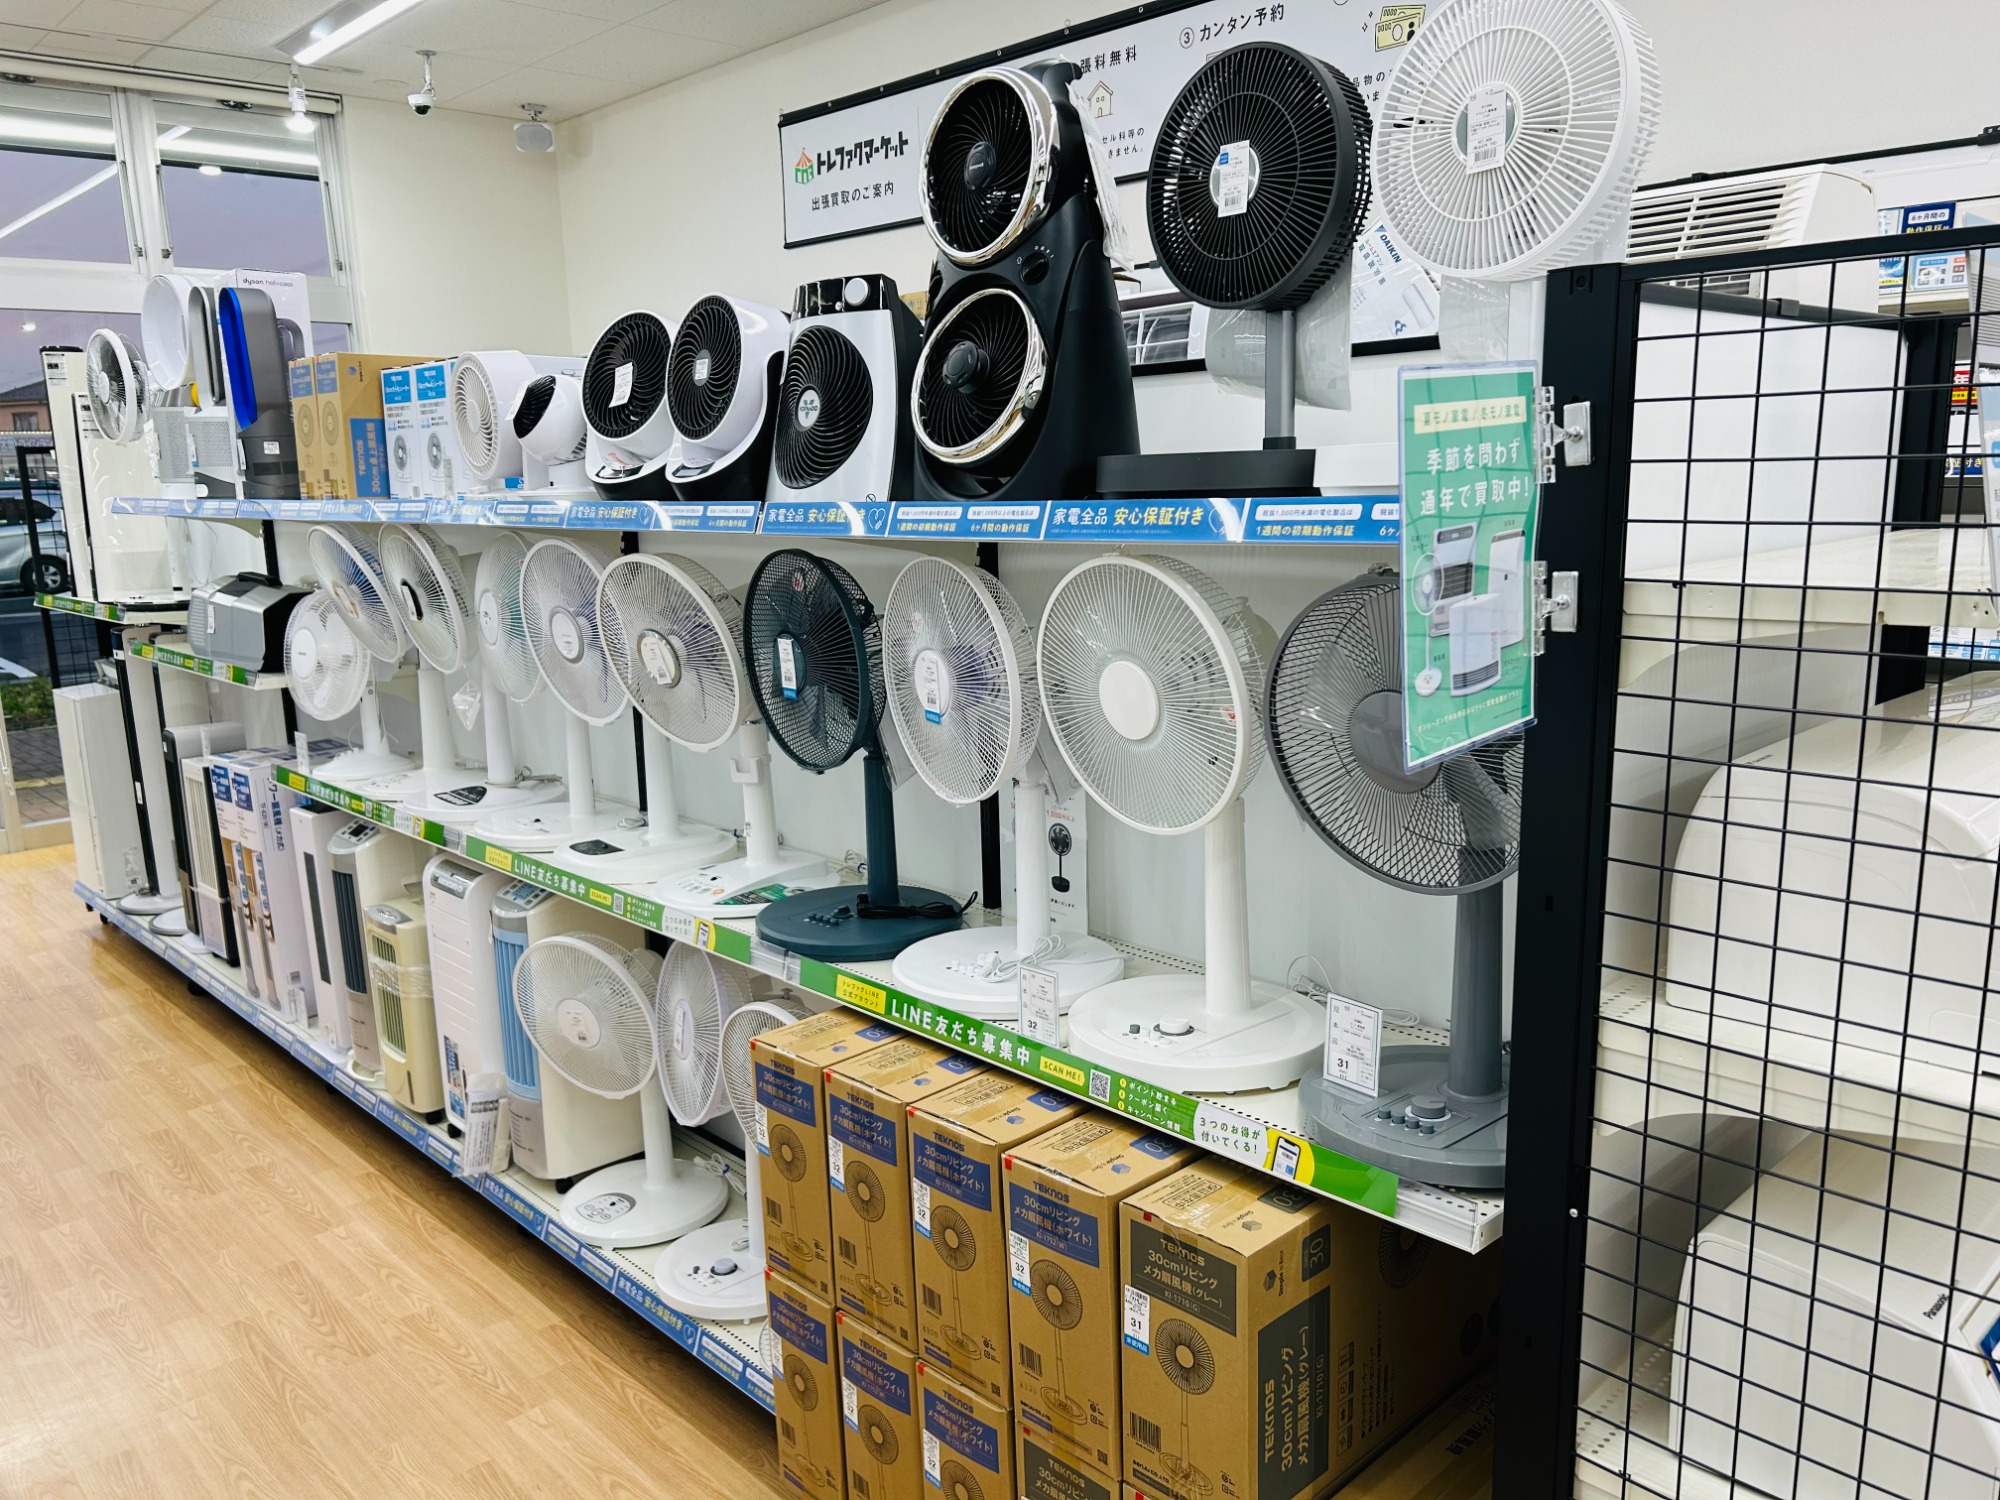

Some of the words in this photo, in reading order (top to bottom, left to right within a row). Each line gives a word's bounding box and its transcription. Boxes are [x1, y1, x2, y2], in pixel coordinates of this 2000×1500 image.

[1199, 2, 1285, 43] カンタン予約
[817, 131, 909, 175] トレファクマーケット
[812, 181, 894, 211] 出張買取のご案内
[1380, 234, 1402, 263] DAIKIN
[1427, 437, 1520, 475] 季節を問わず
[768, 508, 804, 523] 家電全品
[808, 508, 866, 524] 安心保証き
[1052, 507, 1108, 525] 家電全品
[1113, 507, 1204, 526] 安心保証付き
[1256, 525, 1356, 537] 1週間の初期動作保証
[514, 860, 586, 897] LINE友だち募集中
[842, 989, 879, 1009] 公式アカウント
[891, 998, 1031, 1067] LINE友だち募集中
[1028, 1019, 1037, 1030] 32
[1043, 1060, 1065, 1075] SCAN
[1337, 1057, 1349, 1070] 31
[846, 1092, 875, 1110] TEKNOS
[933, 1132, 965, 1152] TEKNOS
[925, 1145, 974, 1175] 30cmリビング
[1033, 1181, 1070, 1204] TEKNOS
[1024, 1195, 1080, 1226] 30cmリビング
[1014, 1206, 1092, 1247] メカ扇風機(ホワイト)
[1160, 1238, 1205, 1267] TEKNOS
[1309, 1238, 1324, 1267] 30
[1015, 1262, 1025, 1275] 32
[1148, 1249, 1218, 1290] 30cmリビング
[1143, 1265, 1223, 1308] メカ扇風機(グレー)
[1130, 1317, 1142, 1330] 31
[859, 1338, 888, 1360] TEKNOS
[942, 1389, 974, 1414] TEKNOS
[1280, 1347, 1294, 1472] 30cmリビング
[1297, 1325, 1310, 1465] メカ扇風機(グレー)
[1264, 1378, 1275, 1464] TEKNOS
[1048, 1459, 1085, 1488] TEKNOS
